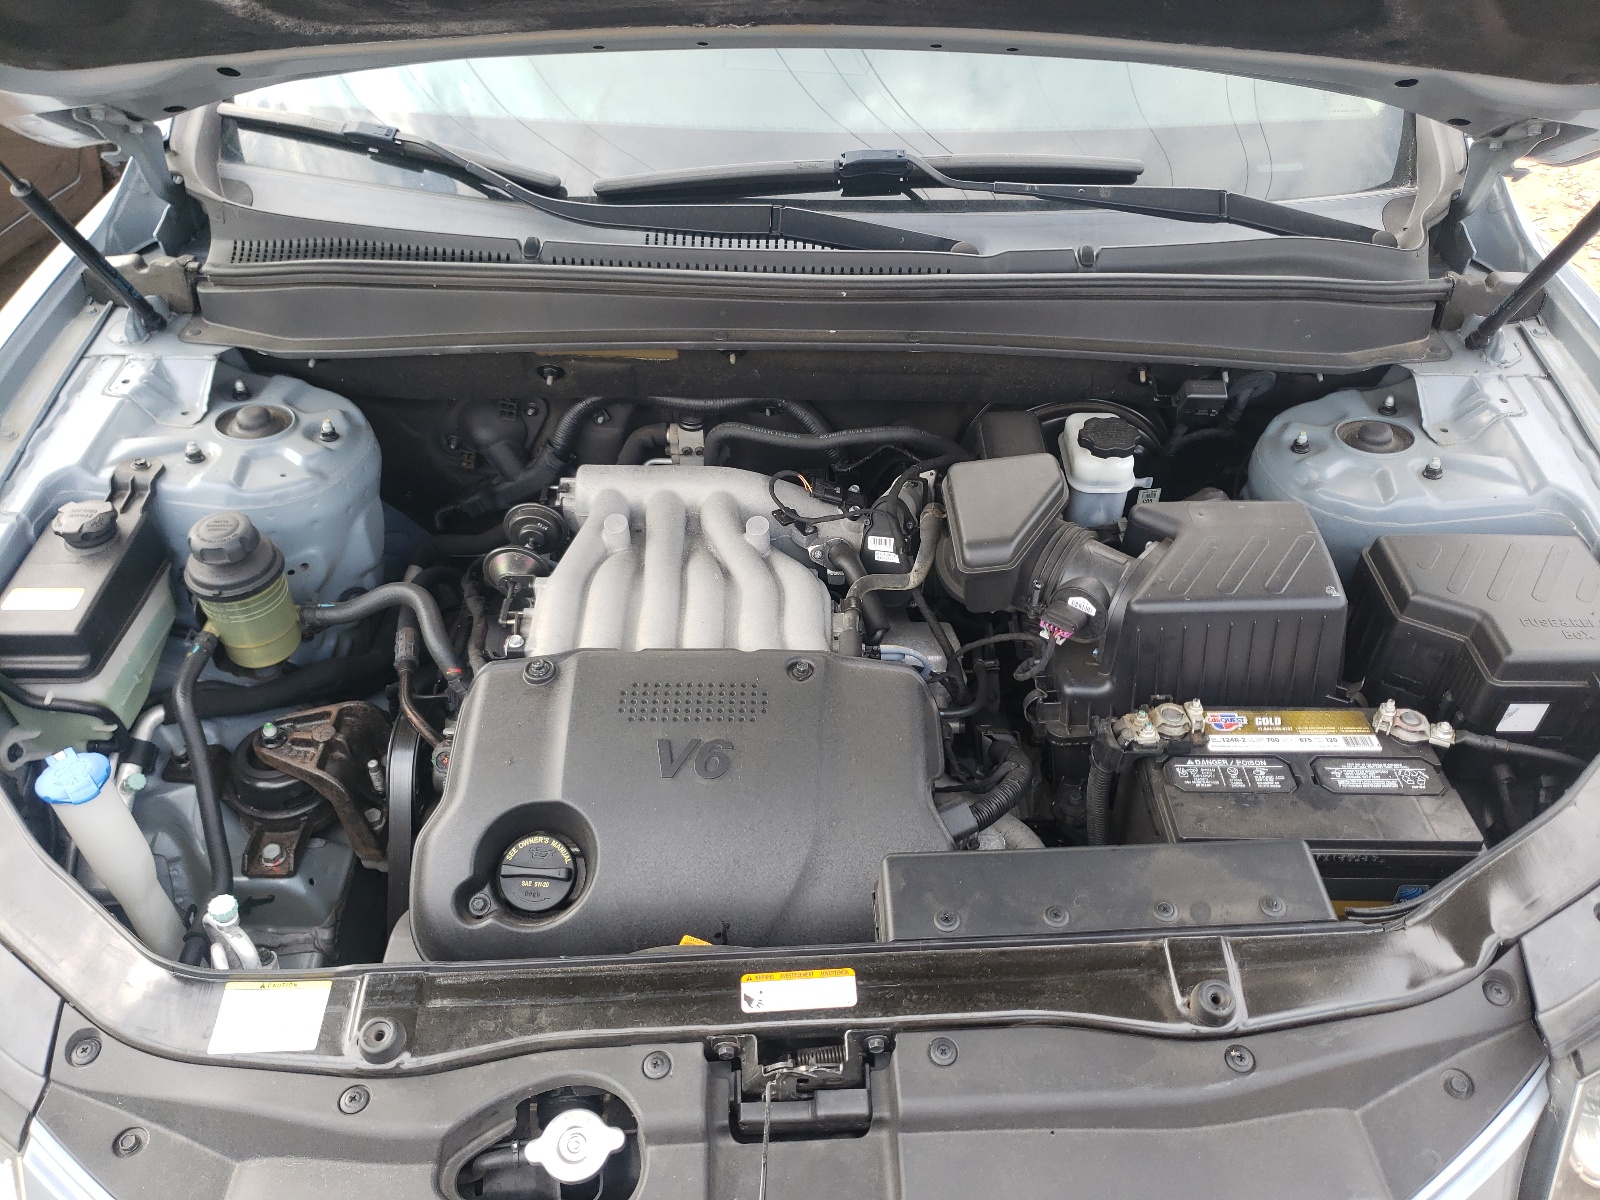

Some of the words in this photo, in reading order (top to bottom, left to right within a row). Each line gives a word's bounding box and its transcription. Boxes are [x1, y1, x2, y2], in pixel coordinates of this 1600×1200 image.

[1518, 618, 1600, 628] FUSE&REL
[1561, 630, 1597, 640] BOX
[1255, 716, 1282, 726] GOLD
[656, 738, 734, 779] V6
[507, 848, 518, 860] SEE
[518, 836, 550, 848] OWNER'S
[551, 840, 571, 864] MANUAL
